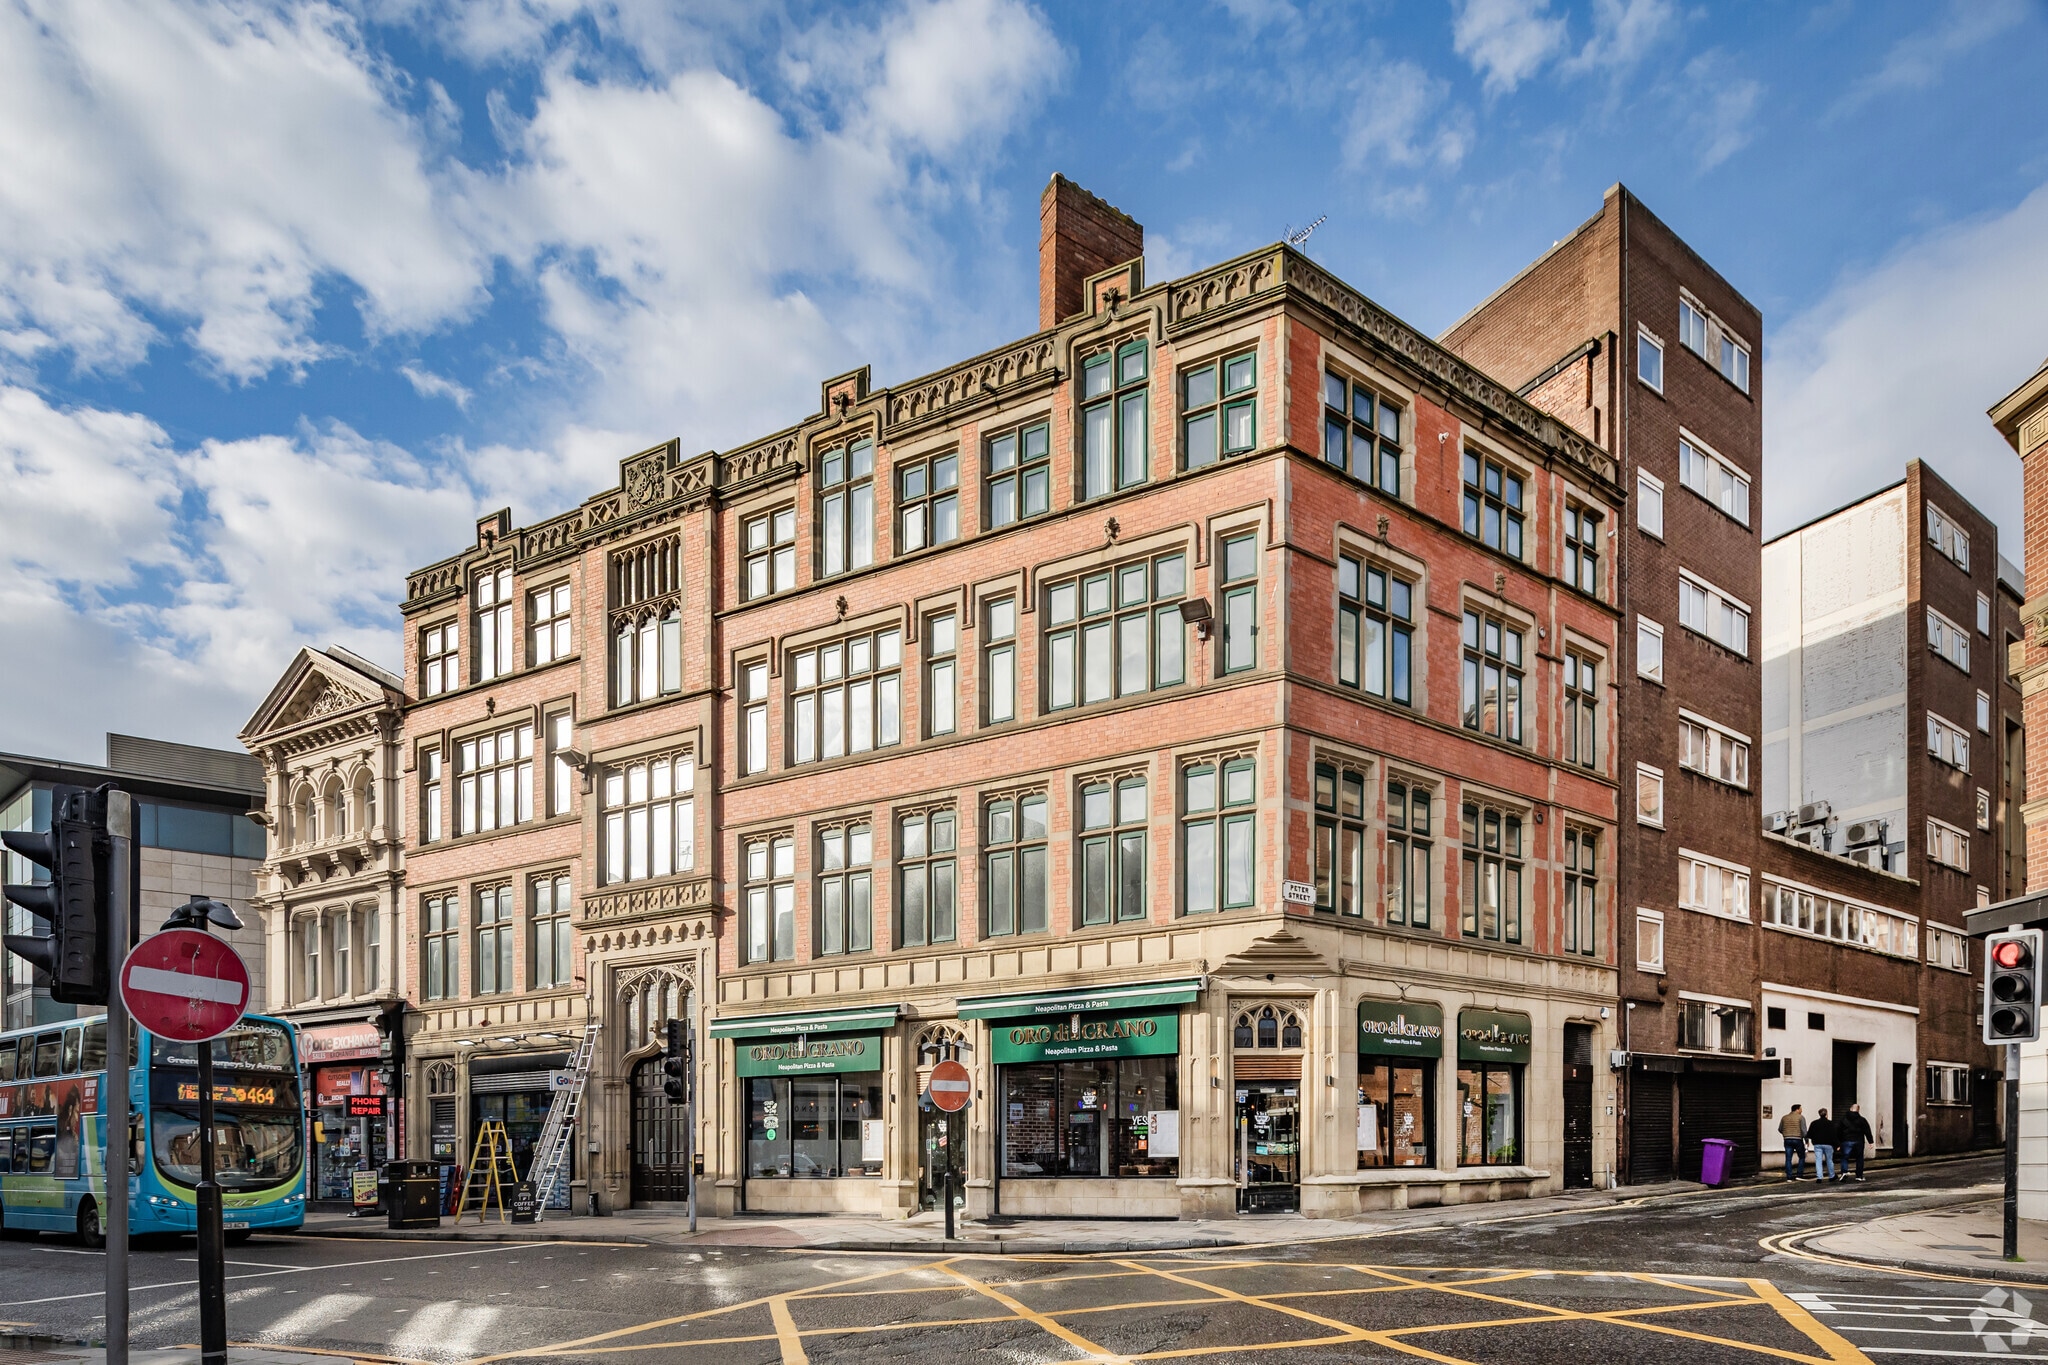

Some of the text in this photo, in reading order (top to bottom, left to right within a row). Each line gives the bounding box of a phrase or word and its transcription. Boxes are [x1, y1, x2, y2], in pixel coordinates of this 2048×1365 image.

[1290, 885, 1308, 893] PETER
[1289, 892, 1310, 901] STREET
[1035, 1004, 1067, 1013] Neapolitan
[1068, 1002, 1084, 1010] Pizza
[232, 1022, 282, 1036] chnology
[1010, 1019, 1157, 1045] ORO di GRANO
[1362, 1020, 1388, 1034] ORO
[1404, 1024, 1442, 1038] GRANO
[750, 1045, 784, 1060] ORO
[806, 1039, 865, 1058] GRANO
[1045, 1047, 1077, 1056] Neapolitan
[245, 1061, 256, 1070] by
[257, 1062, 282, 1070] Arriva
[248, 1087, 275, 1104] 464
